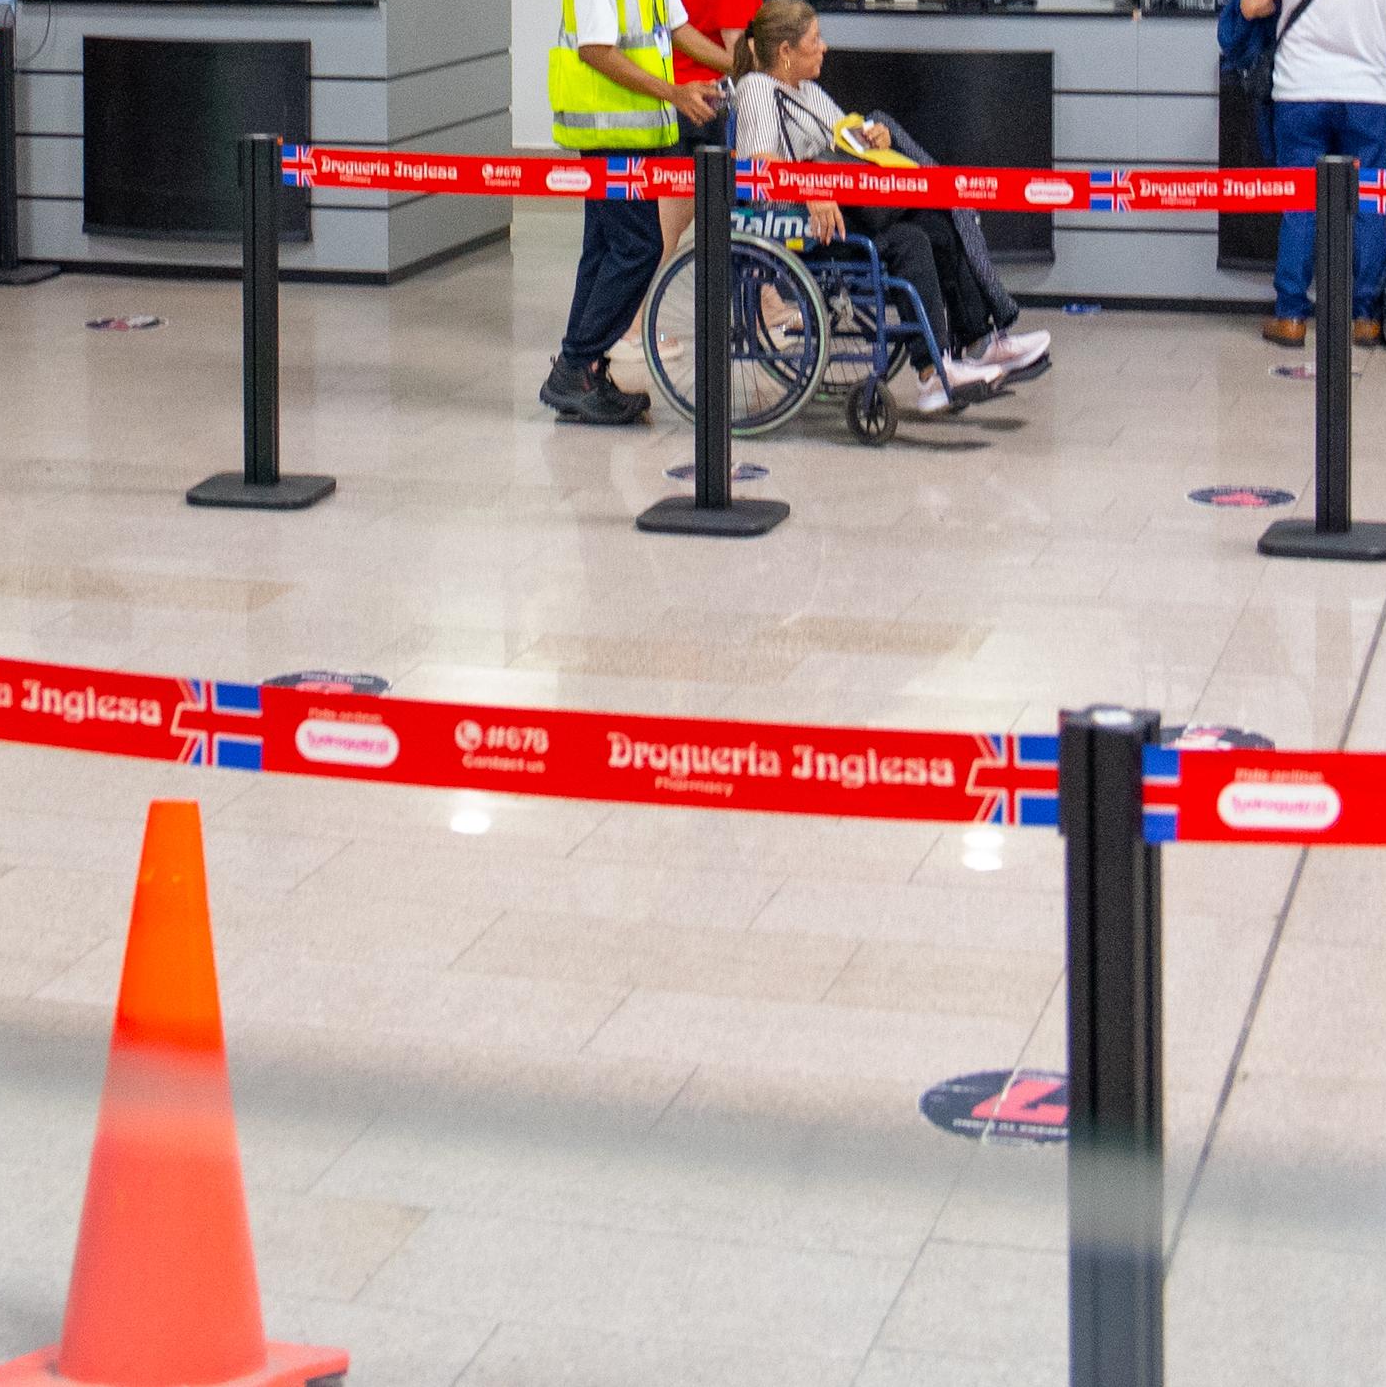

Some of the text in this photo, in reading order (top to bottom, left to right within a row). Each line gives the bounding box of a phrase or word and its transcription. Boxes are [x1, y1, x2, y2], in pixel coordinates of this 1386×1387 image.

[394, 160, 458, 181] Inglesa
[653, 166, 695, 186] Drogu
[858, 173, 929, 193] Inglesa
[1223, 179, 1296, 198] Inglesa
[21, 678, 164, 728] Inglesa
[486, 725, 550, 754] #678
[607, 730, 956, 789] Droguería Inglesa
